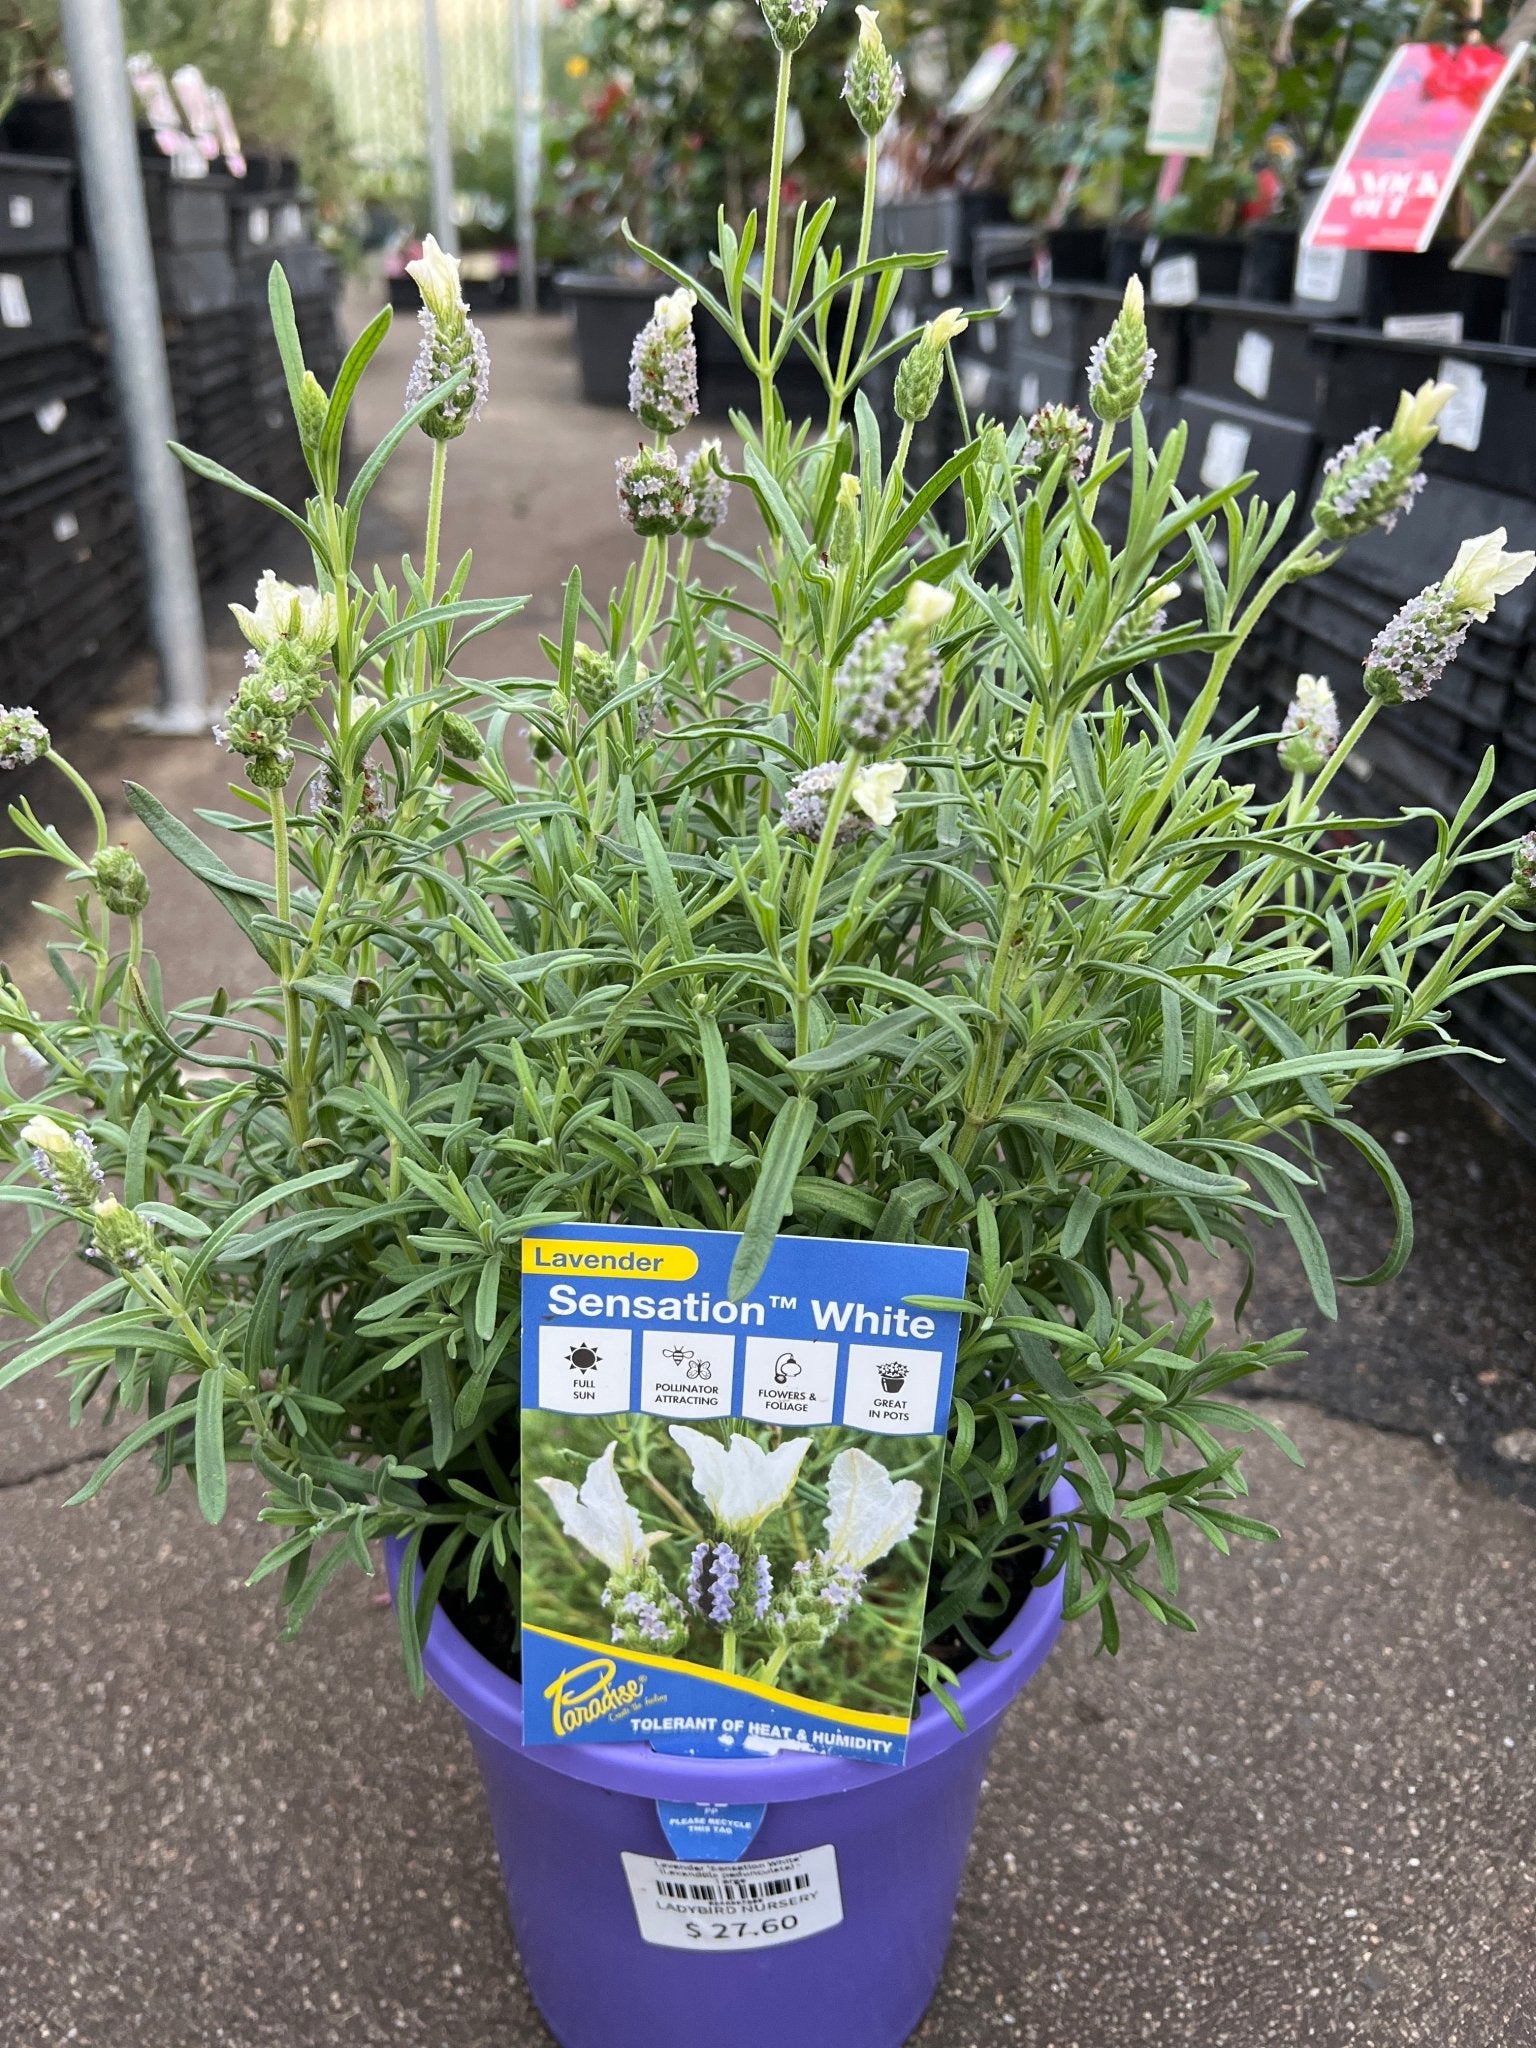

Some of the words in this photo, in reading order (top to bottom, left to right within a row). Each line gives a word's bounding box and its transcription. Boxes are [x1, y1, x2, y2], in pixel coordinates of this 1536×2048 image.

[535, 1246, 664, 1272] Lavender
[811, 1299, 936, 1340] White
[573, 1379, 596, 1389] FULL
[655, 1383, 719, 1394] POLLINATOR
[573, 1391, 596, 1400] SUN
[655, 1395, 719, 1406] ATTRACTING
[758, 1389, 806, 1401] FLOWERS
[808, 1392, 817, 1401] &
[765, 1401, 809, 1412] FOLIAGE
[873, 1398, 908, 1409] GREAT
[868, 1409, 880, 1418] IN
[883, 1411, 910, 1421] POTS
[630, 1716, 718, 1732] TOLERANT
[722, 1718, 744, 1732] OF
[748, 1721, 792, 1739] HEAT
[796, 1729, 807, 1741] &
[812, 1730, 893, 1754] HUMIDITY
[669, 1817, 706, 1826] PLEASE
[707, 1817, 752, 1829] RECYCLE
[688, 1825, 711, 1834] THIS
[713, 1826, 733, 1834] TAG
[656, 1900, 737, 1915] LADYBIRD
[741, 1890, 819, 1913] NURSERY
[686, 1921, 702, 1939] $
[711, 1914, 799, 1940] 27.60
